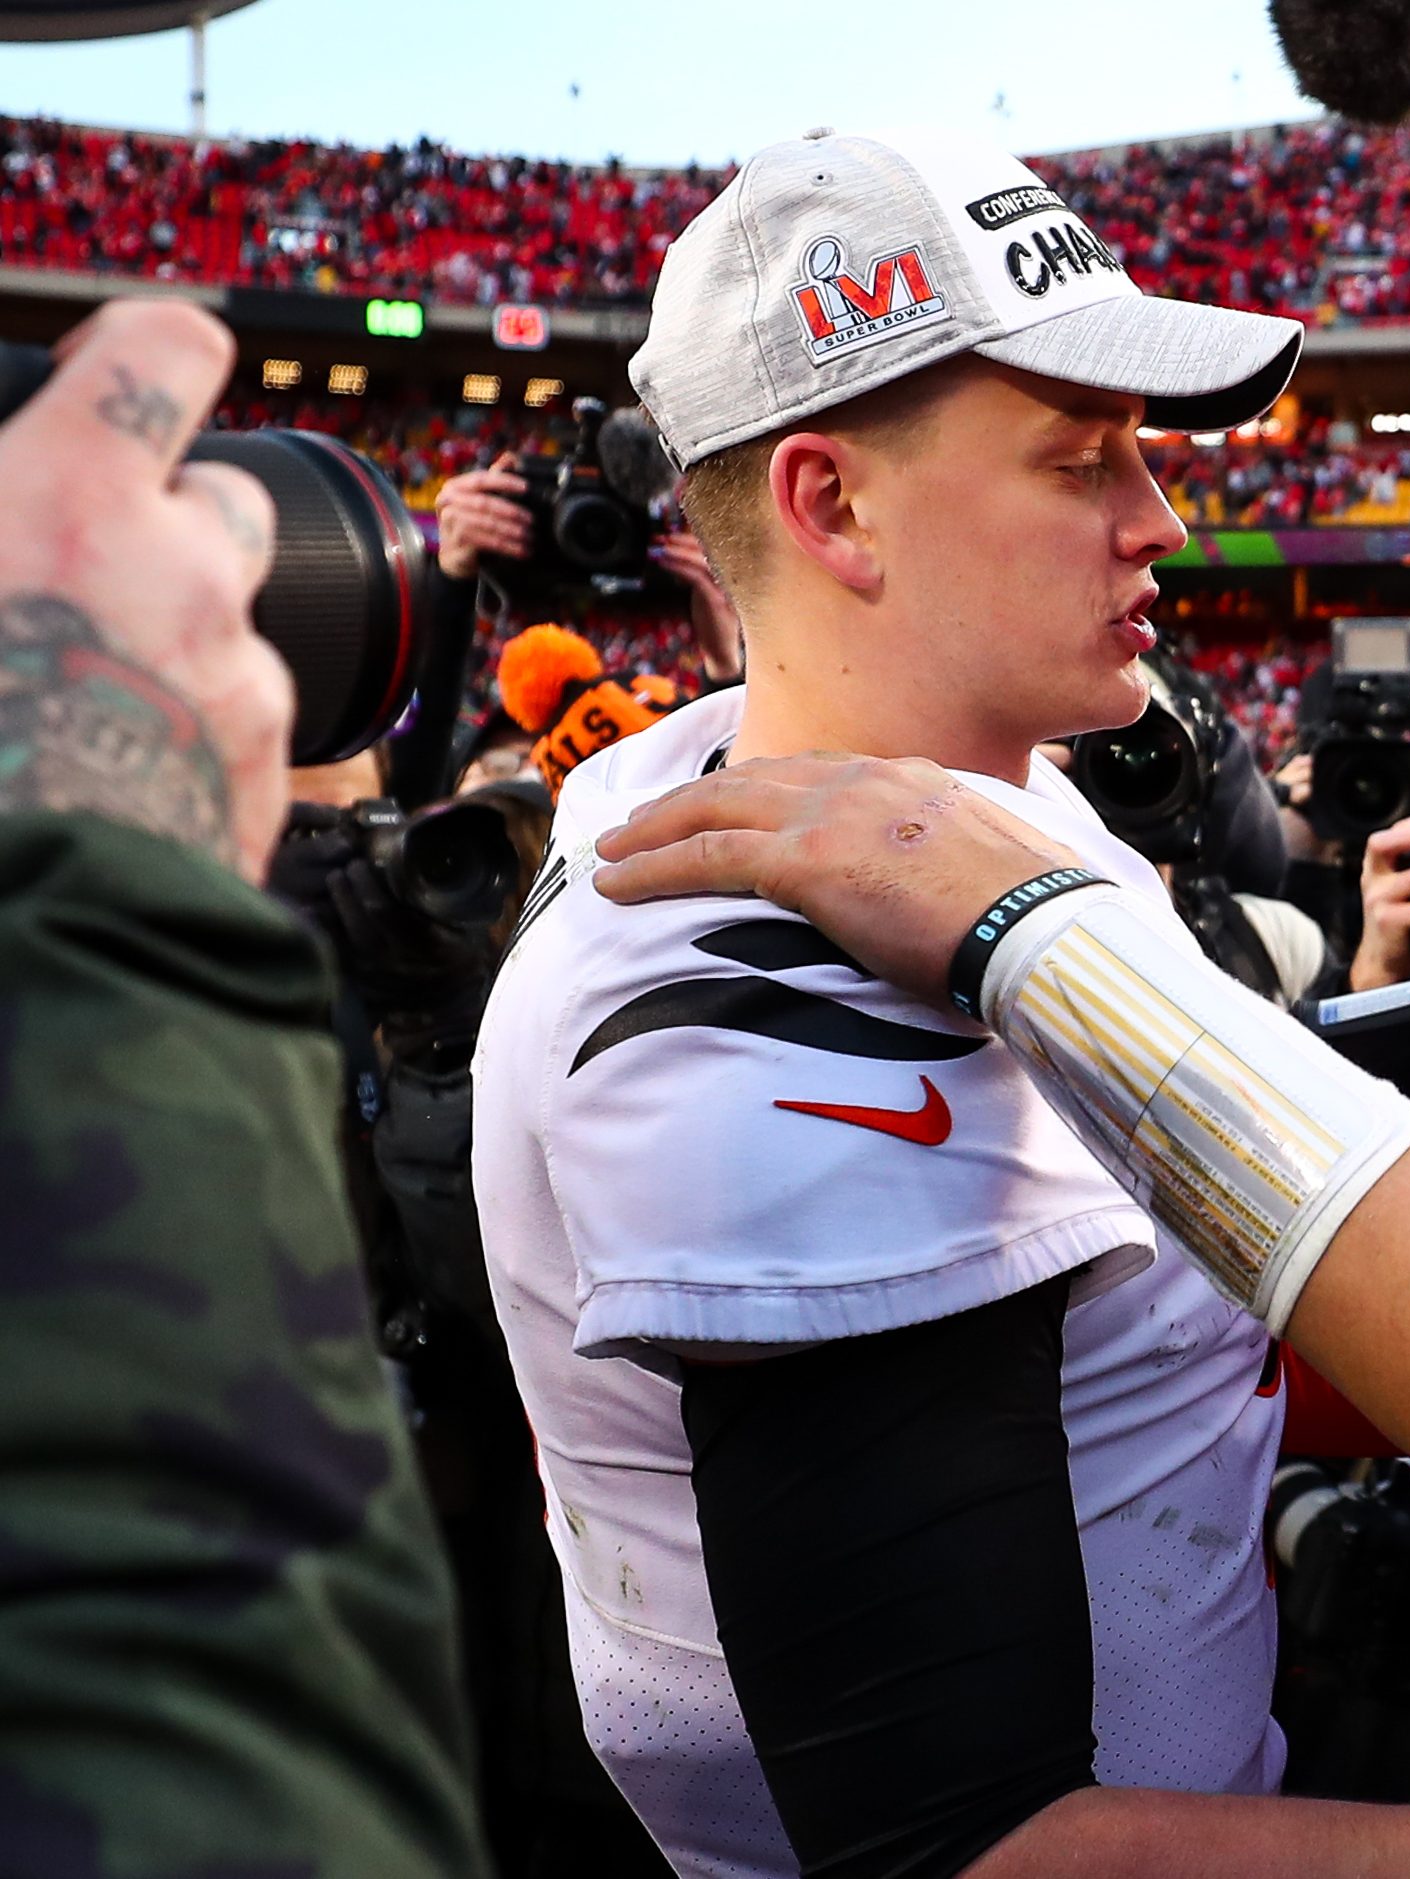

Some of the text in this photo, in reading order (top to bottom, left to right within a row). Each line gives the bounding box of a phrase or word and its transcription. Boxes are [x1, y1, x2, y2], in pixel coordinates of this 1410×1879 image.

[796, 250, 934, 339] LVI
[824, 305, 930, 347] SUPER BOWL
